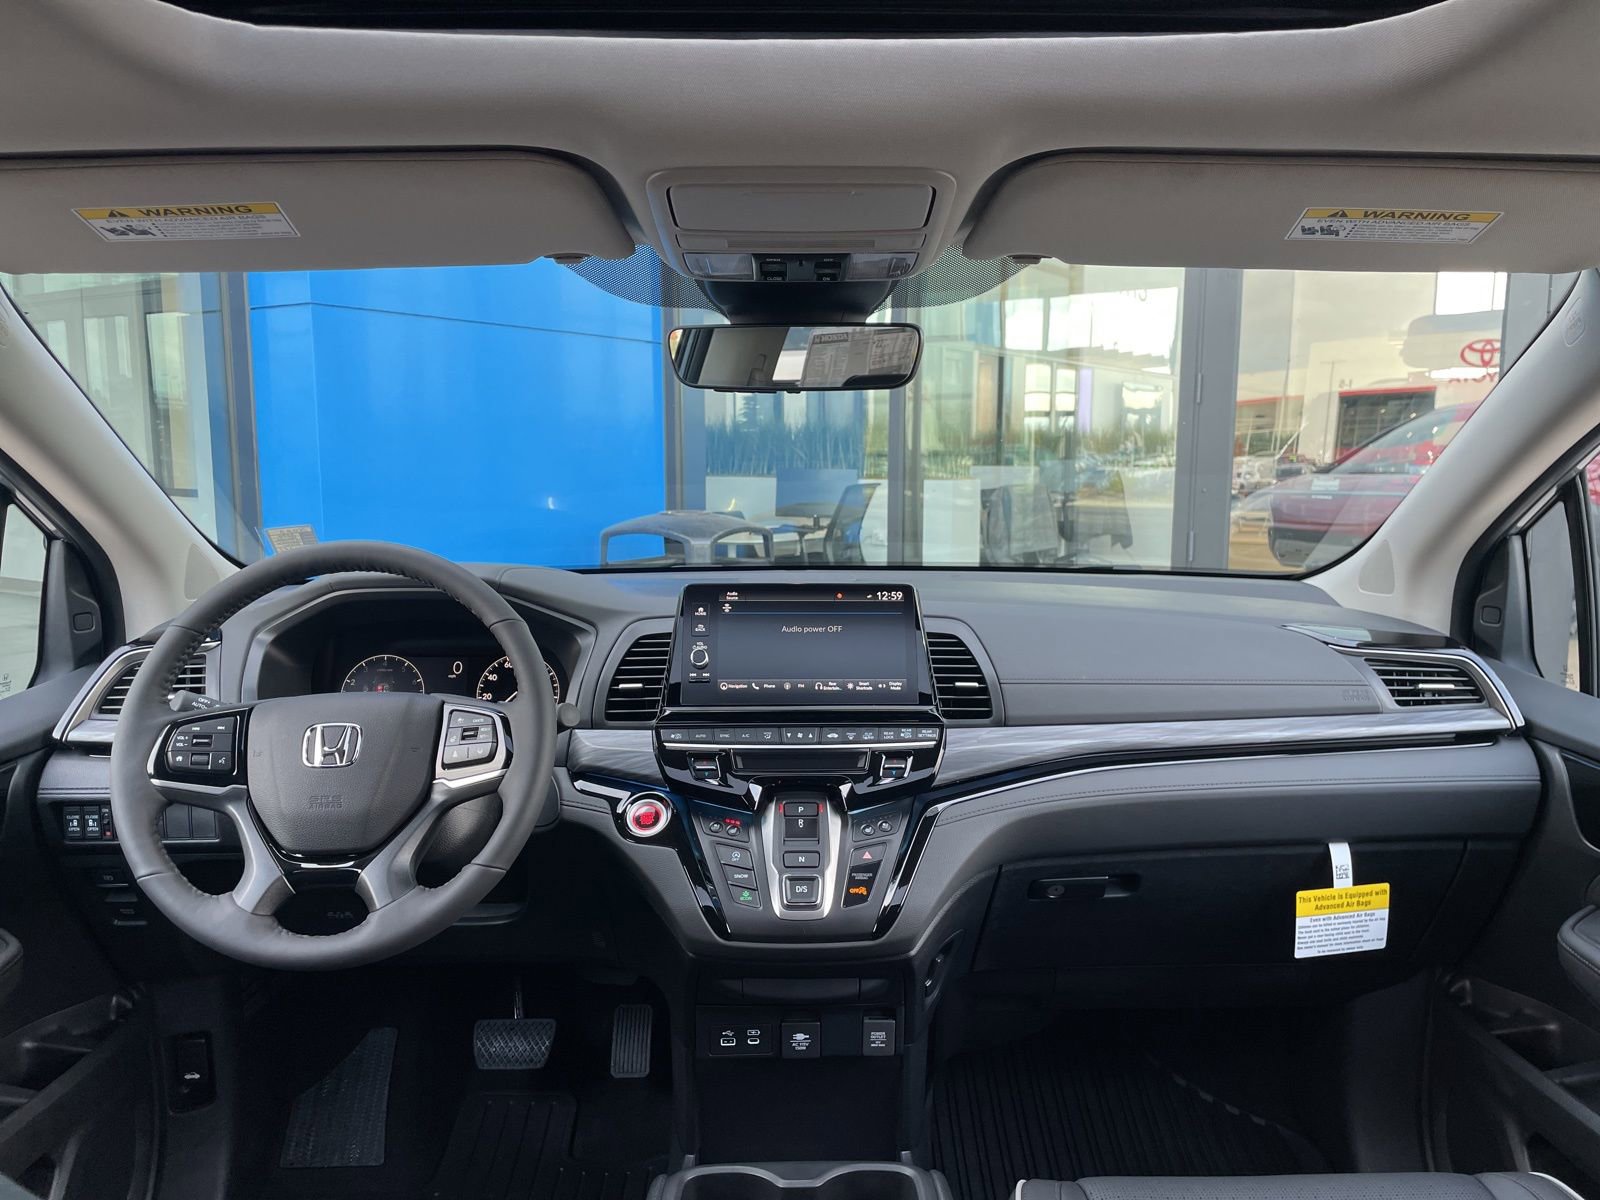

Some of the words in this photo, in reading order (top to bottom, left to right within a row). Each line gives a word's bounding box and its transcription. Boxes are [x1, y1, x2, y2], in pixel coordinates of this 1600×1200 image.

[137, 204, 253, 217] WARNING
[1363, 210, 1471, 221] WARNING
[876, 591, 903, 601] 12:59
[781, 625, 802, 633] Audio
[803, 626, 826, 634] power
[827, 625, 843, 633] OFF
[452, 661, 463, 674] 0
[350, 678, 356, 686] 2
[487, 673, 498, 681] 40
[795, 885, 808, 893] D/S
[1298, 896, 1312, 904] This
[1313, 894, 1336, 902] Vehicle
[1345, 890, 1373, 900] Equipped
[1374, 888, 1388, 896] with
[1314, 902, 1344, 910] Advanced
[1346, 900, 1355, 908] Air
[1356, 899, 1372, 908] Bags
[1364, 911, 1376, 919] Bags
